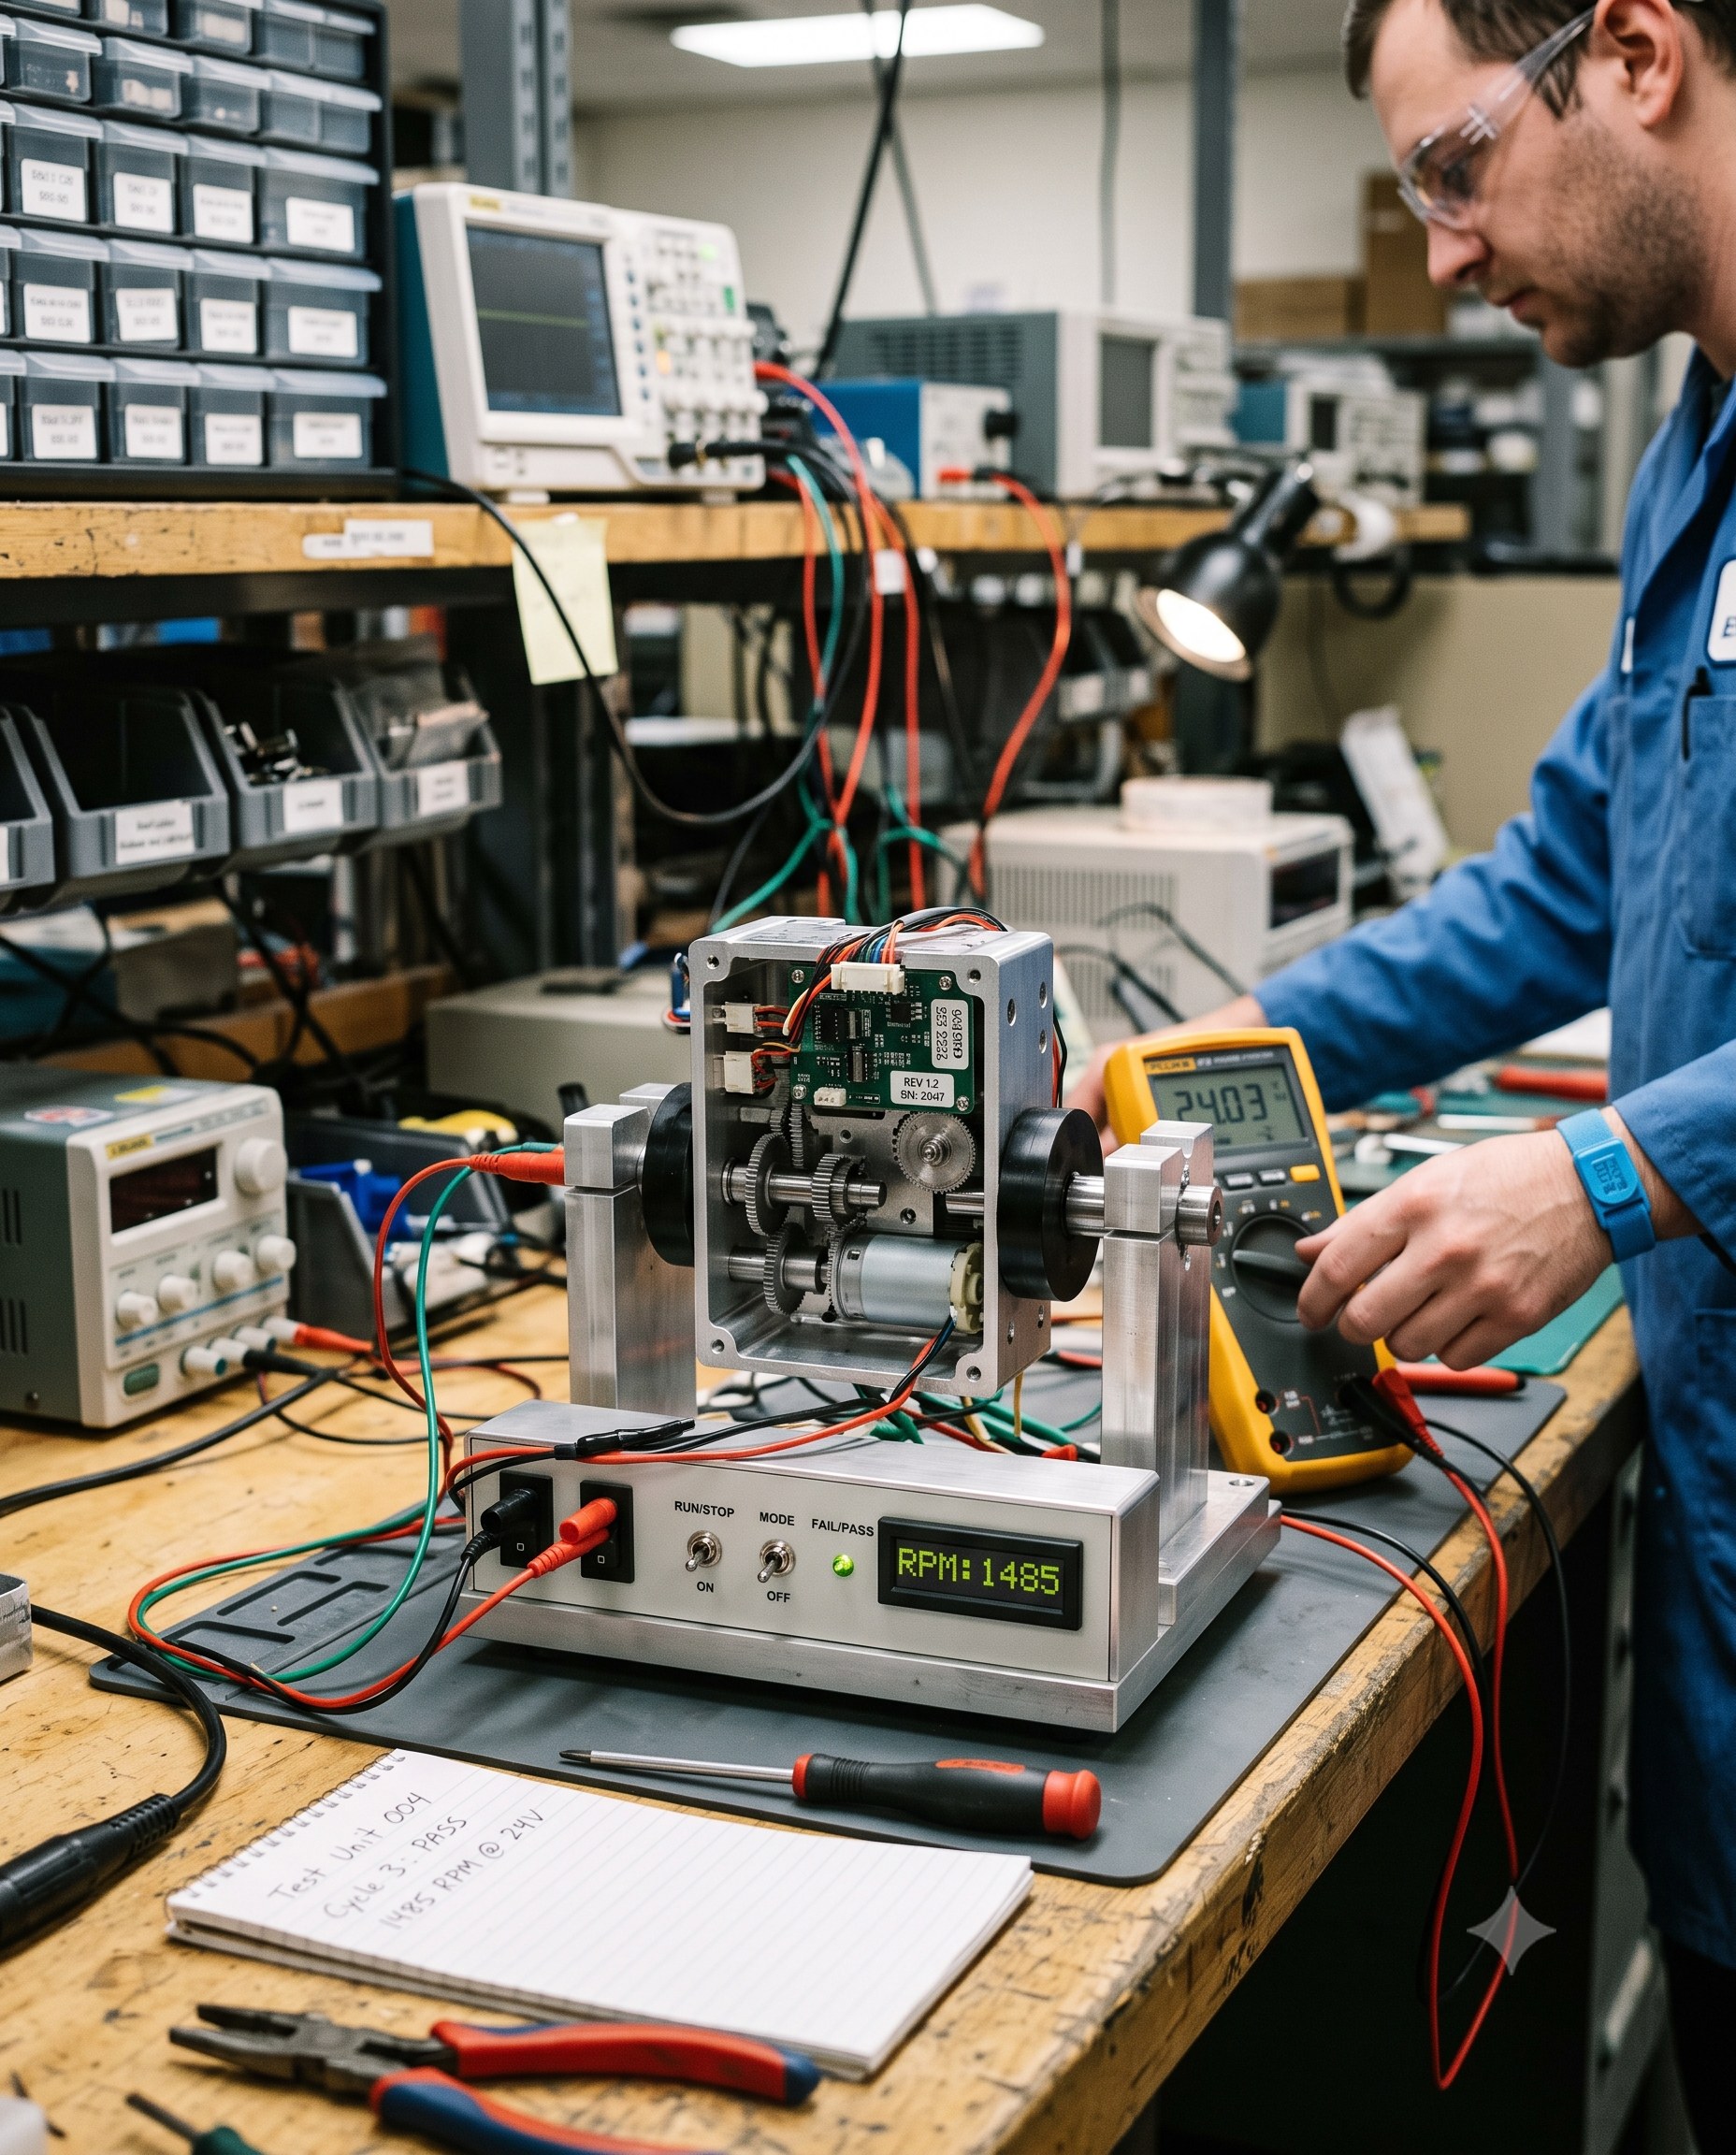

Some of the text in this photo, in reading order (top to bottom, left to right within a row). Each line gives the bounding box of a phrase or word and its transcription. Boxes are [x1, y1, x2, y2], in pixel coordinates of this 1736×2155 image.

[904, 1077, 939, 1089] REV 1.2
[900, 1090, 945, 1102] SN: 2047
[674, 1500, 735, 1518] RUN/STOP
[760, 1511, 795, 1526] MODE
[811, 1518, 875, 1537] FAIL/PASS
[696, 1581, 715, 1593] ON
[766, 1590, 791, 1603] OFF
[268, 1791, 432, 1901] Test Unit 004
[323, 1881, 384, 1919] Cycle
[411, 1815, 468, 1852] PASS
[378, 1808, 544, 1930] 1485 RPM @ 24V
